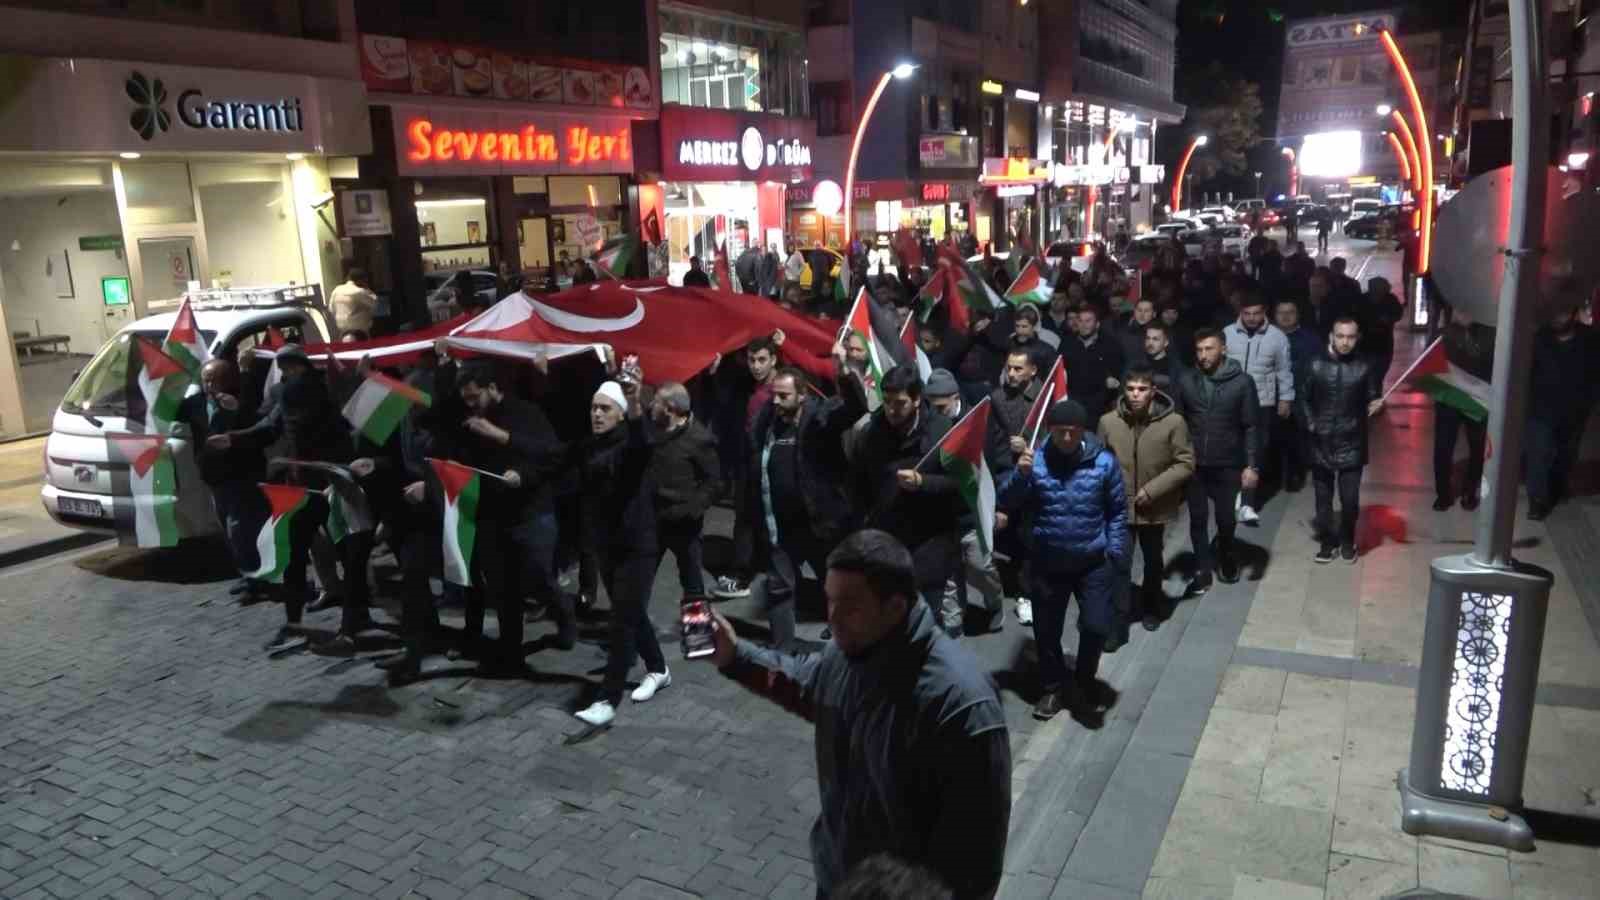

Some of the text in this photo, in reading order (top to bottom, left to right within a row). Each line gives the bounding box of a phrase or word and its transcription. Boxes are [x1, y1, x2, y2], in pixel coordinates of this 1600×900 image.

[177, 89, 303, 131] Garanti
[408, 119, 629, 166] Sevenin Yeri
[679, 140, 738, 165] MERKEZ
